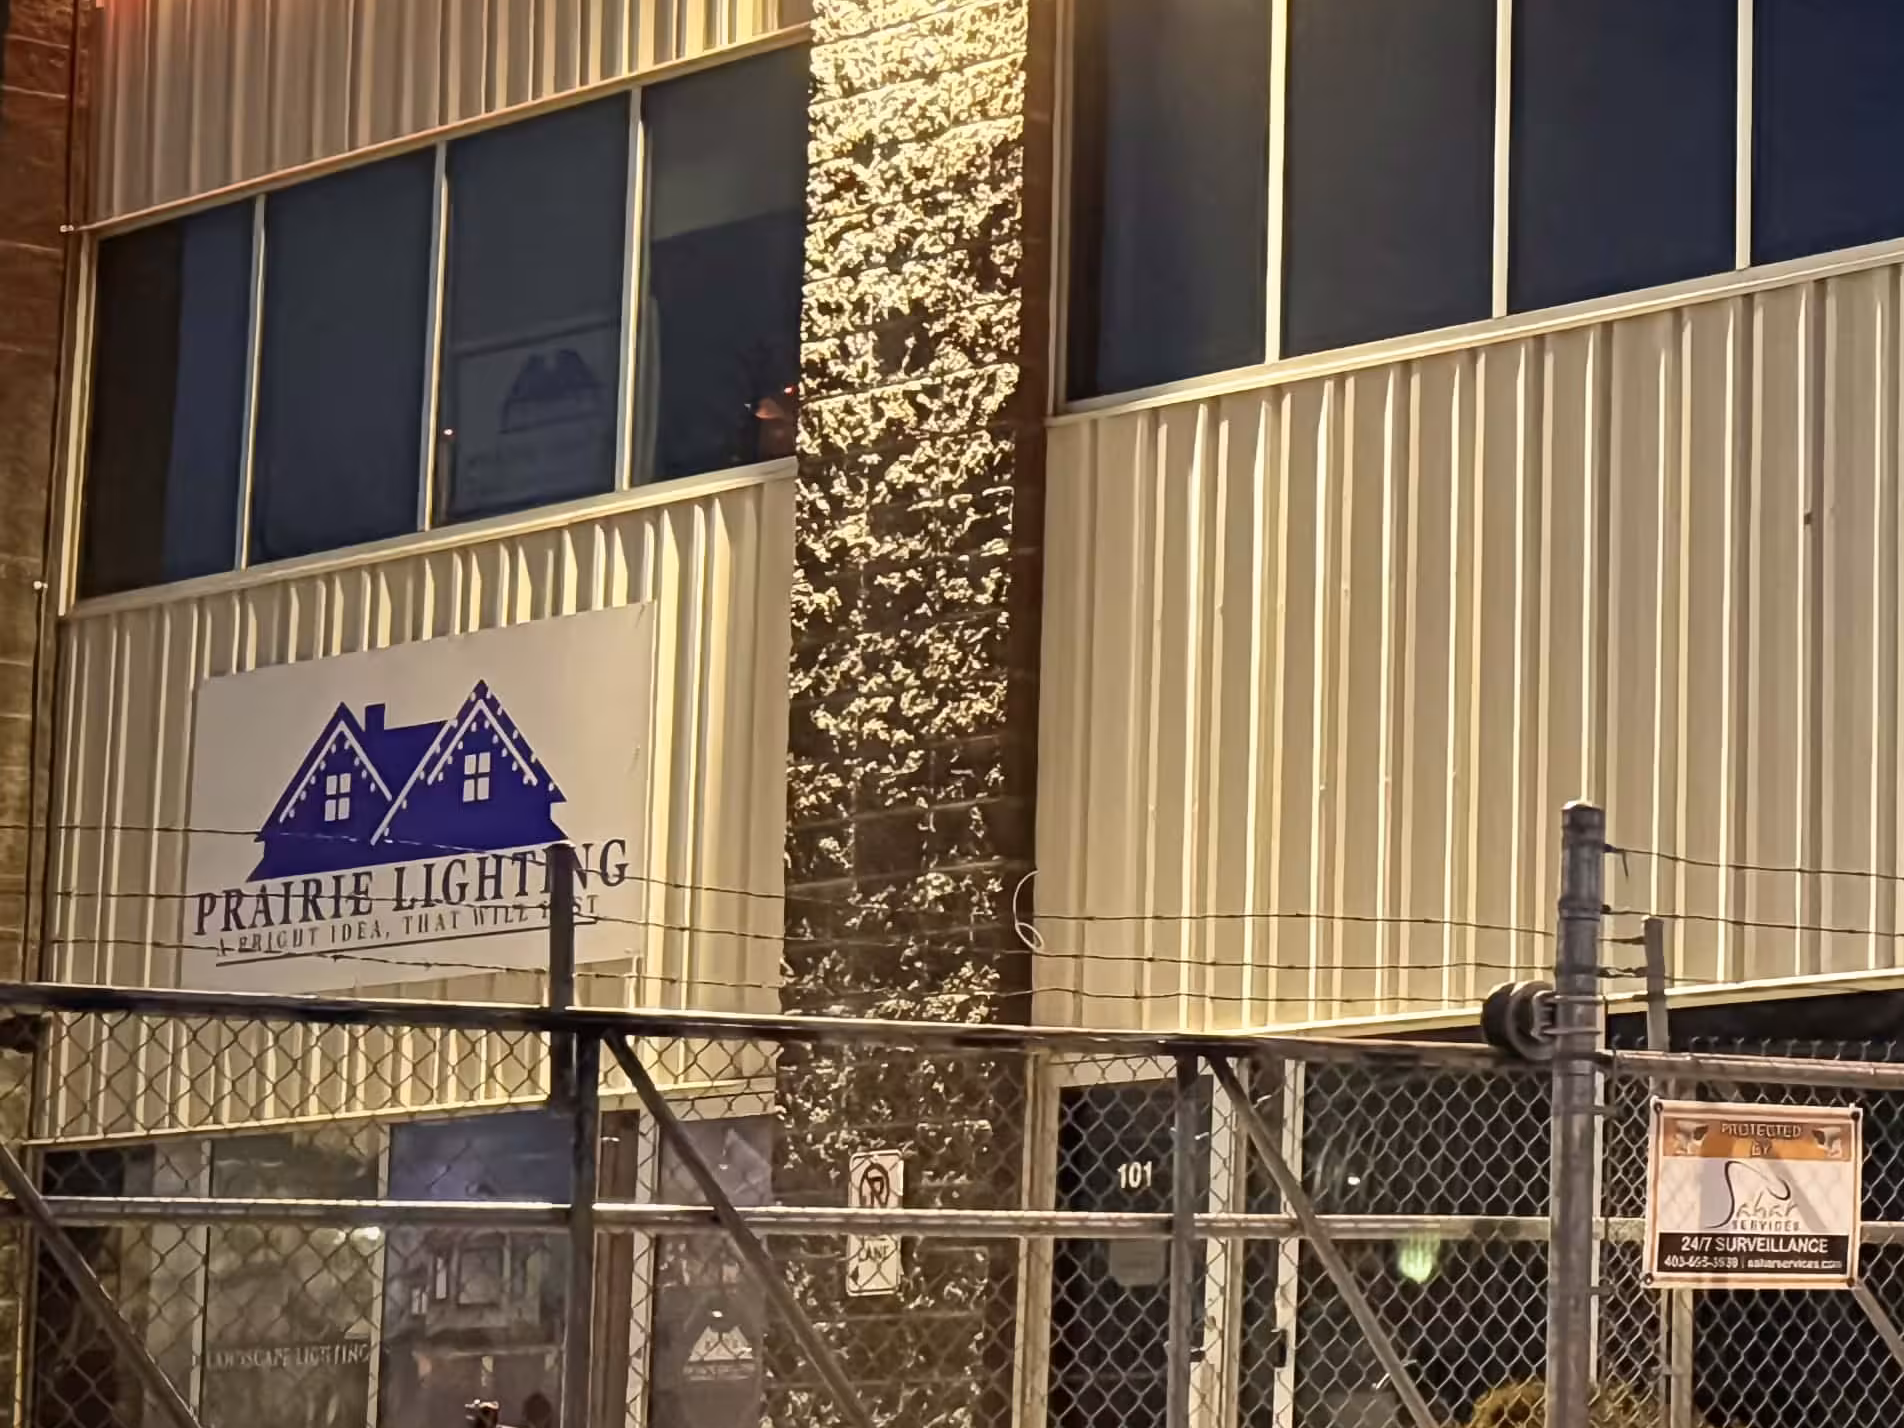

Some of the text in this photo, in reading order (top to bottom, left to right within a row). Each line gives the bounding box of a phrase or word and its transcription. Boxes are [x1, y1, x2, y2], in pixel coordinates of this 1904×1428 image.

[193, 838, 630, 936] PRAIRIE LIGHTING
[238, 927, 321, 954] BRIGHT
[331, 920, 391, 944] IDEA,
[402, 910, 460, 935] THAT
[473, 906, 529, 927] WILL
[539, 895, 599, 921] LST
[1721, 1122, 1802, 1138] PROTECTED
[1751, 1142, 1771, 1156] BY
[1117, 1161, 1153, 1189] 101
[1731, 1219, 1801, 1233] SERVICES
[1681, 1235, 1829, 1254] 24/7 SURVEILLANCE
